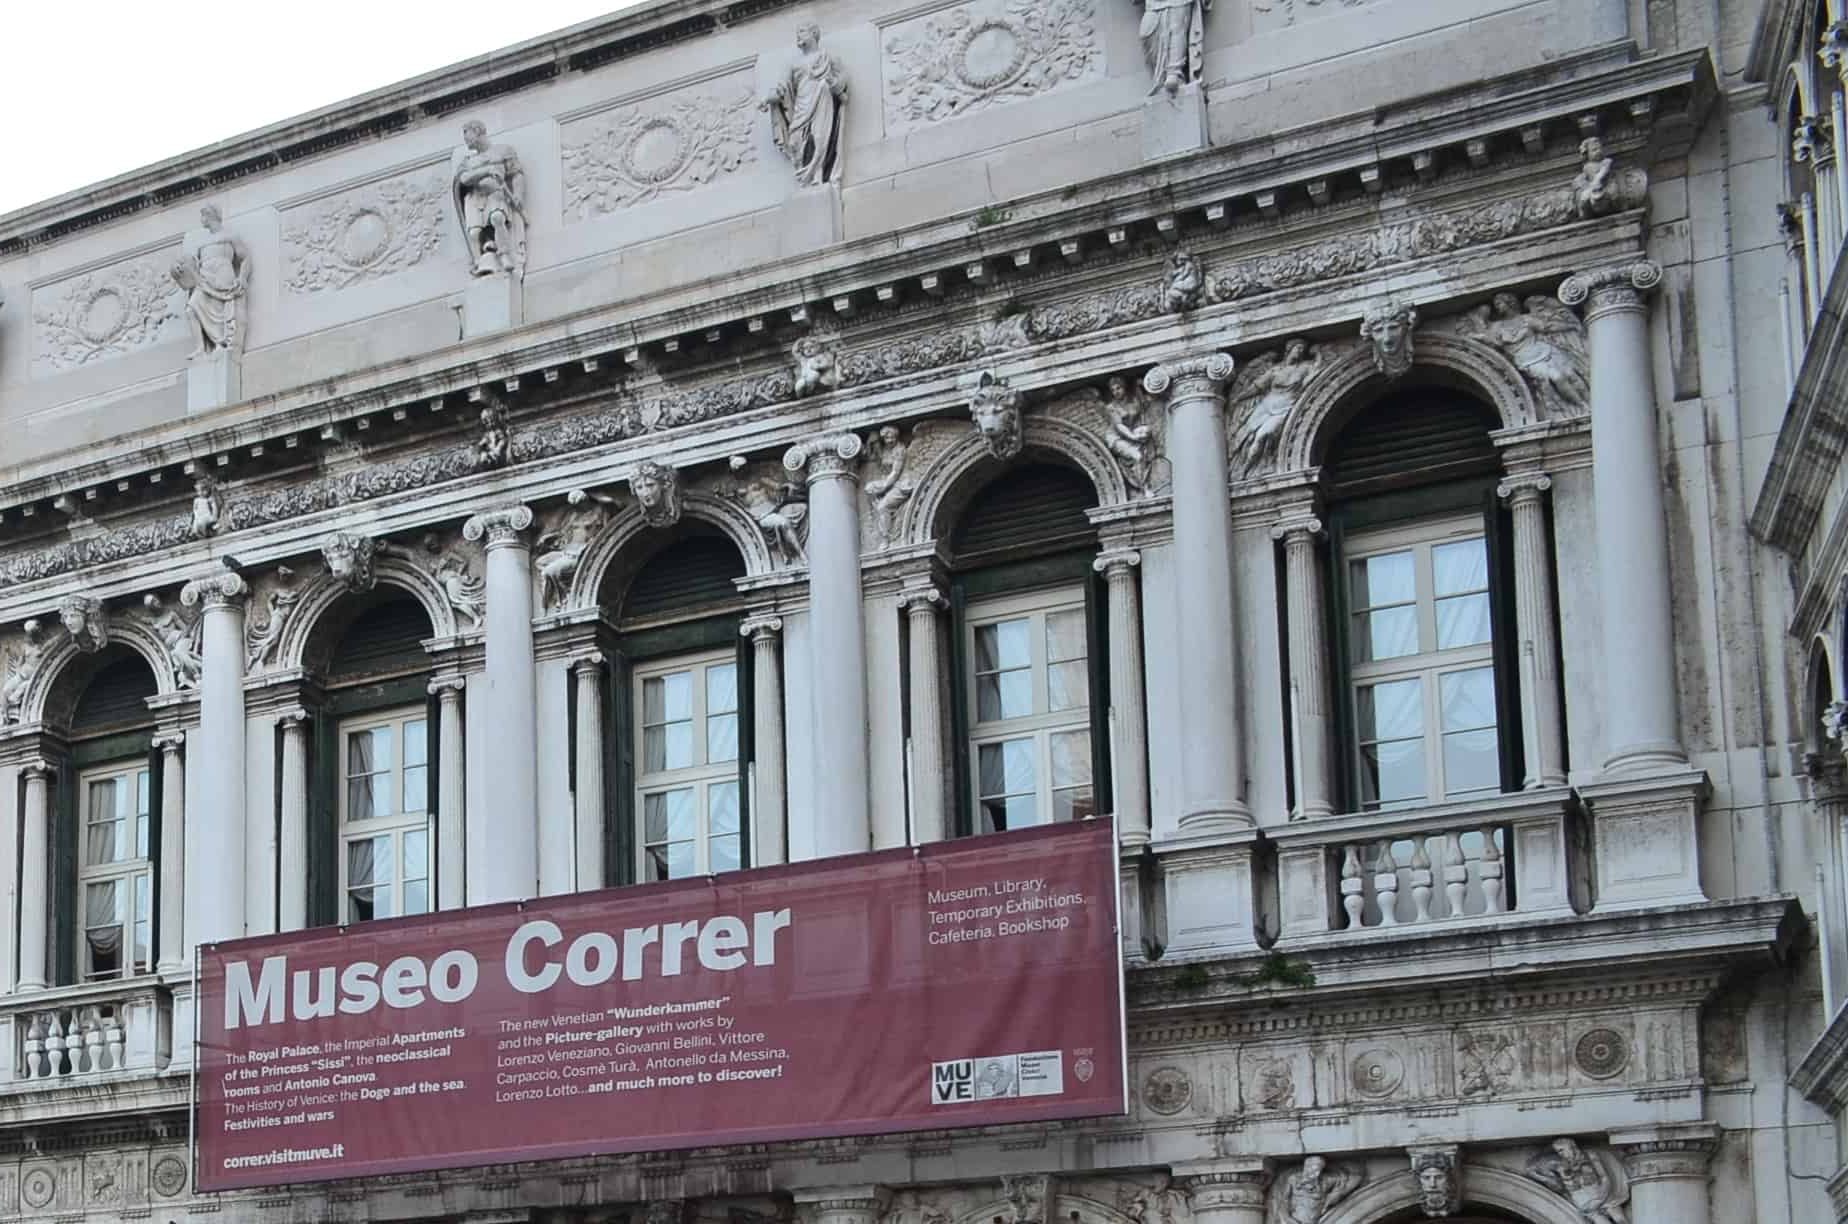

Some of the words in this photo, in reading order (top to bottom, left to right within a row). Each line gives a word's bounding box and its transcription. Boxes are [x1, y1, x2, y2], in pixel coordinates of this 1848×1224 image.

[927, 904, 1003, 924] Temporary
[998, 915, 1070, 936] Bookshop
[223, 949, 478, 1029] Museo
[504, 907, 792, 993] Correr
[497, 1037, 521, 1050] and
[523, 1035, 542, 1046] the
[545, 1025, 644, 1045] Picture-gallery
[646, 1020, 673, 1034] with
[675, 1016, 714, 1031] works
[717, 1015, 734, 1029] by
[499, 1020, 521, 1032] The
[524, 1018, 549, 1029] new
[551, 1012, 604, 1027] Venetian
[225, 1053, 246, 1064] The
[248, 1048, 279, 1062] Royal
[324, 1040, 341, 1053] the
[344, 1036, 390, 1051] Imperial
[391, 1027, 465, 1046] Apartments
[497, 1053, 545, 1068] Lorenzo
[615, 1039, 671, 1055] Giovanni
[718, 1031, 765, 1045] Vittore
[224, 1069, 237, 1081] of
[240, 1068, 258, 1079] the
[261, 1063, 309, 1077] Princess
[356, 1054, 374, 1066] the
[375, 1045, 451, 1063] neoclassical
[645, 1054, 706, 1070] Antonello
[709, 1051, 727, 1064] da
[935, 1061, 972, 1083] MU
[224, 1086, 260, 1098] rooms
[262, 1081, 282, 1093] and
[284, 1076, 329, 1091] Antonio
[496, 1088, 543, 1103] Lorenzo
[616, 1076, 655, 1091] much
[657, 1075, 695, 1087] more
[698, 1071, 712, 1083] to
[716, 1065, 783, 1081] discover!
[935, 1081, 972, 1101] VE
[224, 1103, 245, 1115] The
[247, 1099, 285, 1112] History
[287, 1096, 297, 1107] of
[340, 1089, 358, 1102] the
[360, 1087, 390, 1100] Doge
[393, 1083, 416, 1096] and
[419, 1081, 440, 1093] the
[224, 1115, 281, 1131] Festivities
[283, 1112, 304, 1124] and
[306, 1111, 335, 1121] wars
[223, 1143, 344, 1169] correr.visitmuve.it
